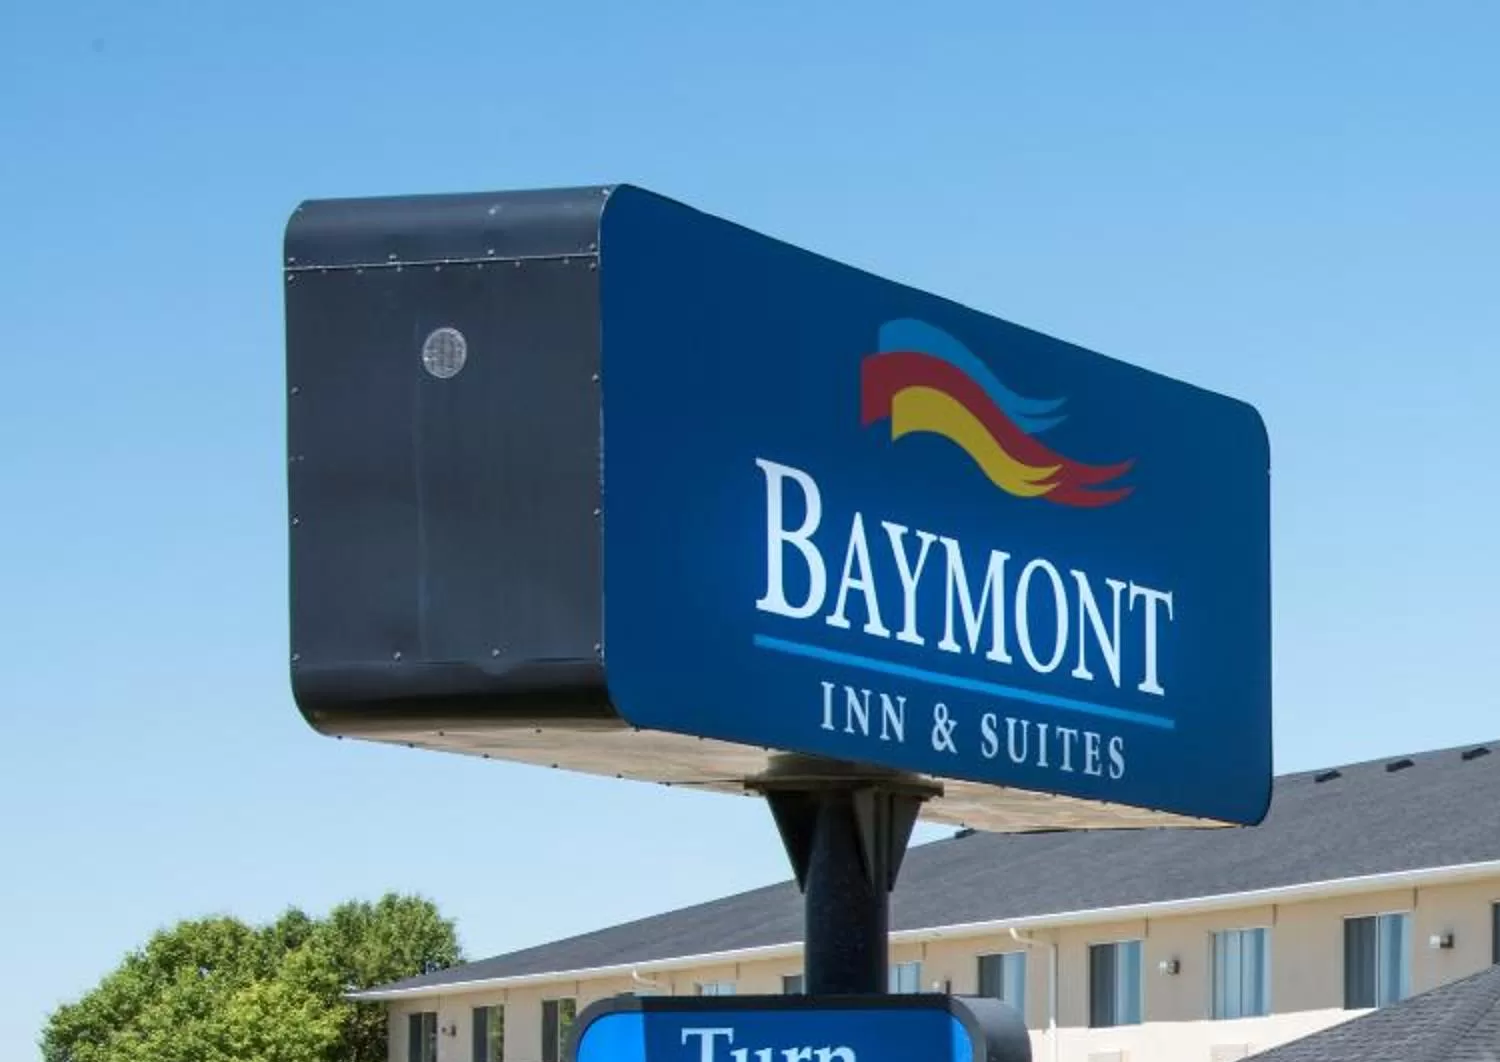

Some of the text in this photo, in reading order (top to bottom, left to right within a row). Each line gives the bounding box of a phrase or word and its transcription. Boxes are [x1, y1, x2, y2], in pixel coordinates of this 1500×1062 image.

[754, 457, 1175, 697] BAYMONT
[820, 681, 1126, 781] INN & SUITES
